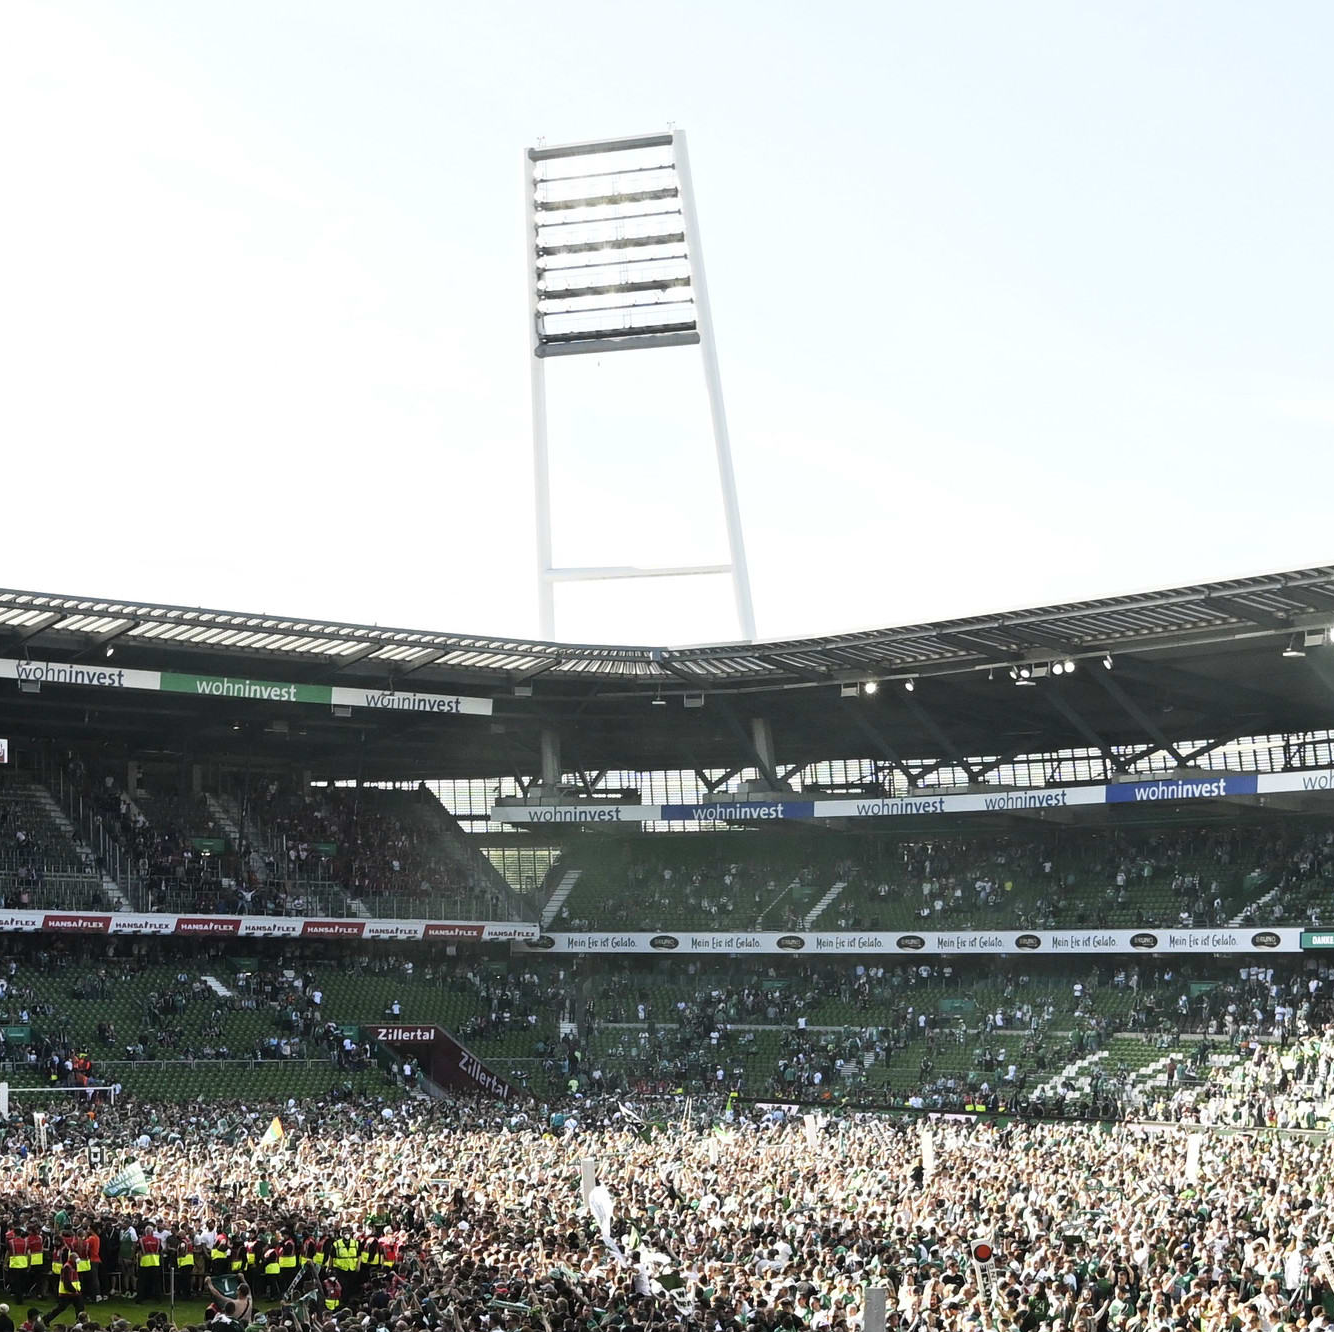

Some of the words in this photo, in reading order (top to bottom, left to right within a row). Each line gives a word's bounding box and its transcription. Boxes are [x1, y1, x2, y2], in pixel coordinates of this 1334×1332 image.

[17, 660, 124, 687] wohninvest
[196, 677, 297, 702] wohninvest
[1134, 778, 1226, 801] wohninvest
[855, 797, 945, 817] wohninvest
[984, 790, 1067, 811] wohninvest
[528, 805, 621, 823] wohninvest
[692, 802, 784, 821] wohninvest
[568, 937, 585, 948] Mein
[692, 937, 709, 948] Mein
[1052, 936, 1068, 947] Mein
[1169, 935, 1187, 947] Mein
[1312, 935, 1334, 945] DANKE.
[377, 1028, 435, 1041] Zillertal
[458, 1051, 509, 1098] Zillertal
